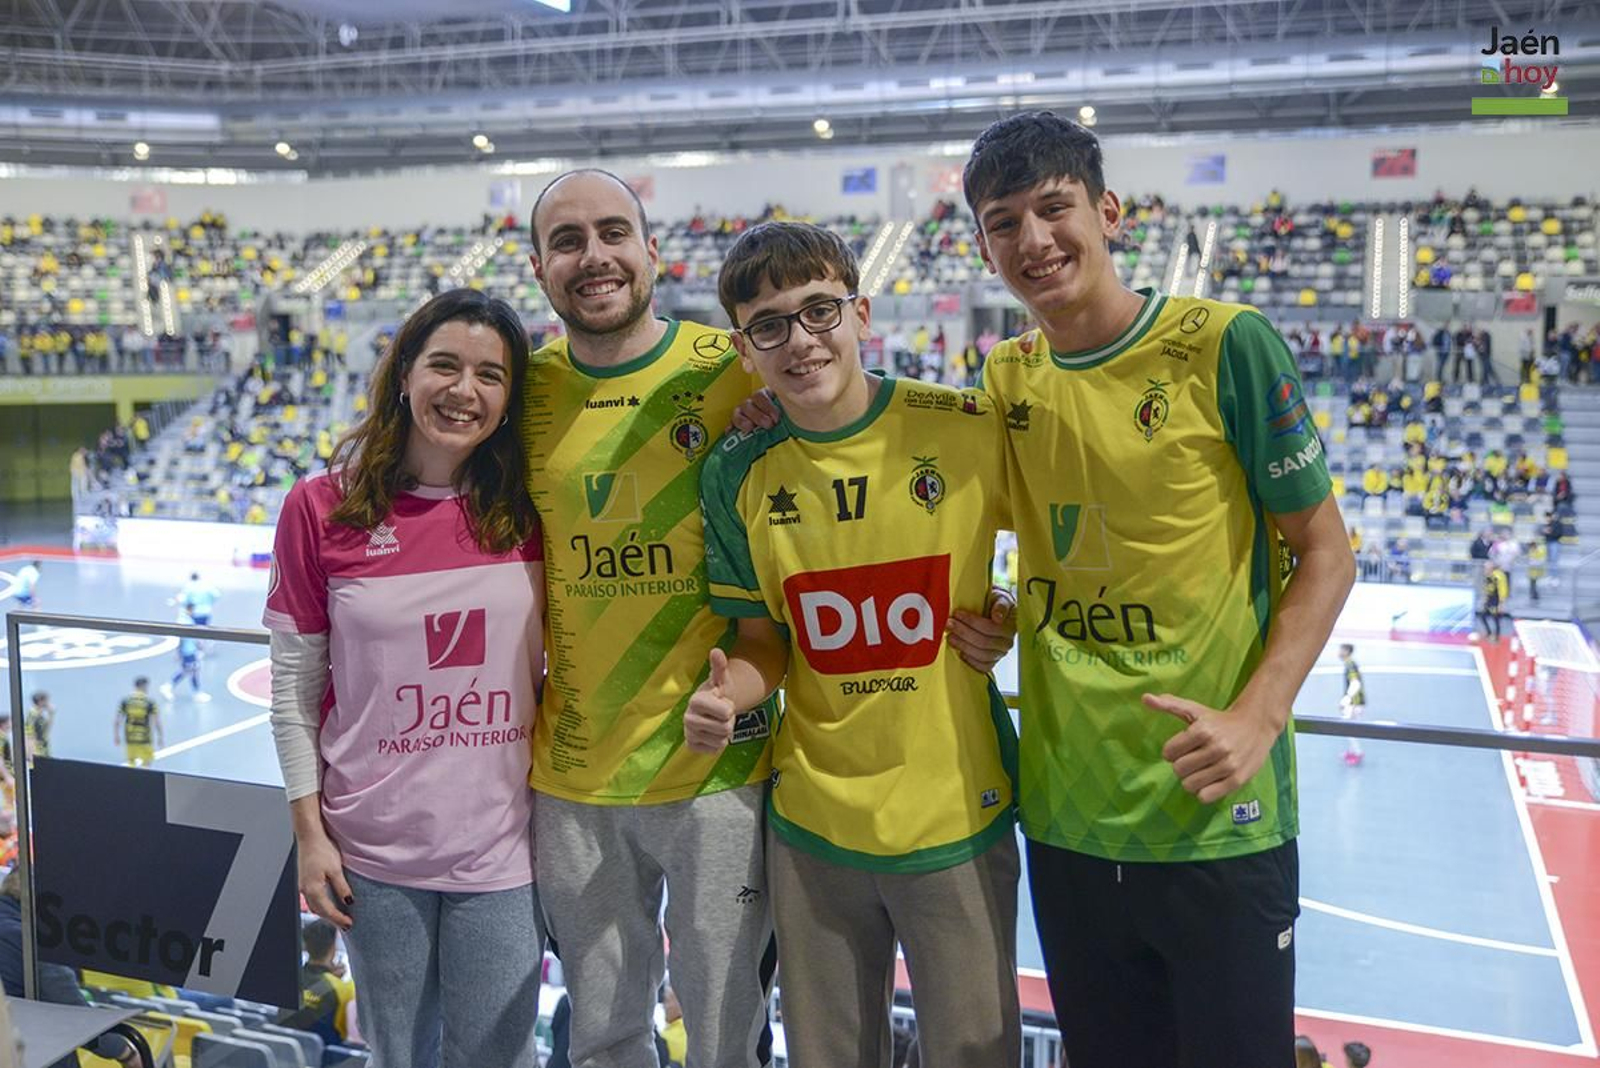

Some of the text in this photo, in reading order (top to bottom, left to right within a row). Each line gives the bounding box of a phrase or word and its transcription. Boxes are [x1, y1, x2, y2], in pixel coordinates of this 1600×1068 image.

[585, 397, 625, 409] luanvi
[768, 516, 801, 526] luanvi
[832, 475, 868, 522] 17
[366, 544, 400, 557] luanvi
[570, 531, 673, 580] Jaén
[565, 579, 696, 598] PARAÍSO INTERIOR
[1026, 576, 1156, 643] Jaén
[396, 677, 511, 735] Jaén
[164, 772, 295, 999] 7
[37, 891, 224, 977] Sector
